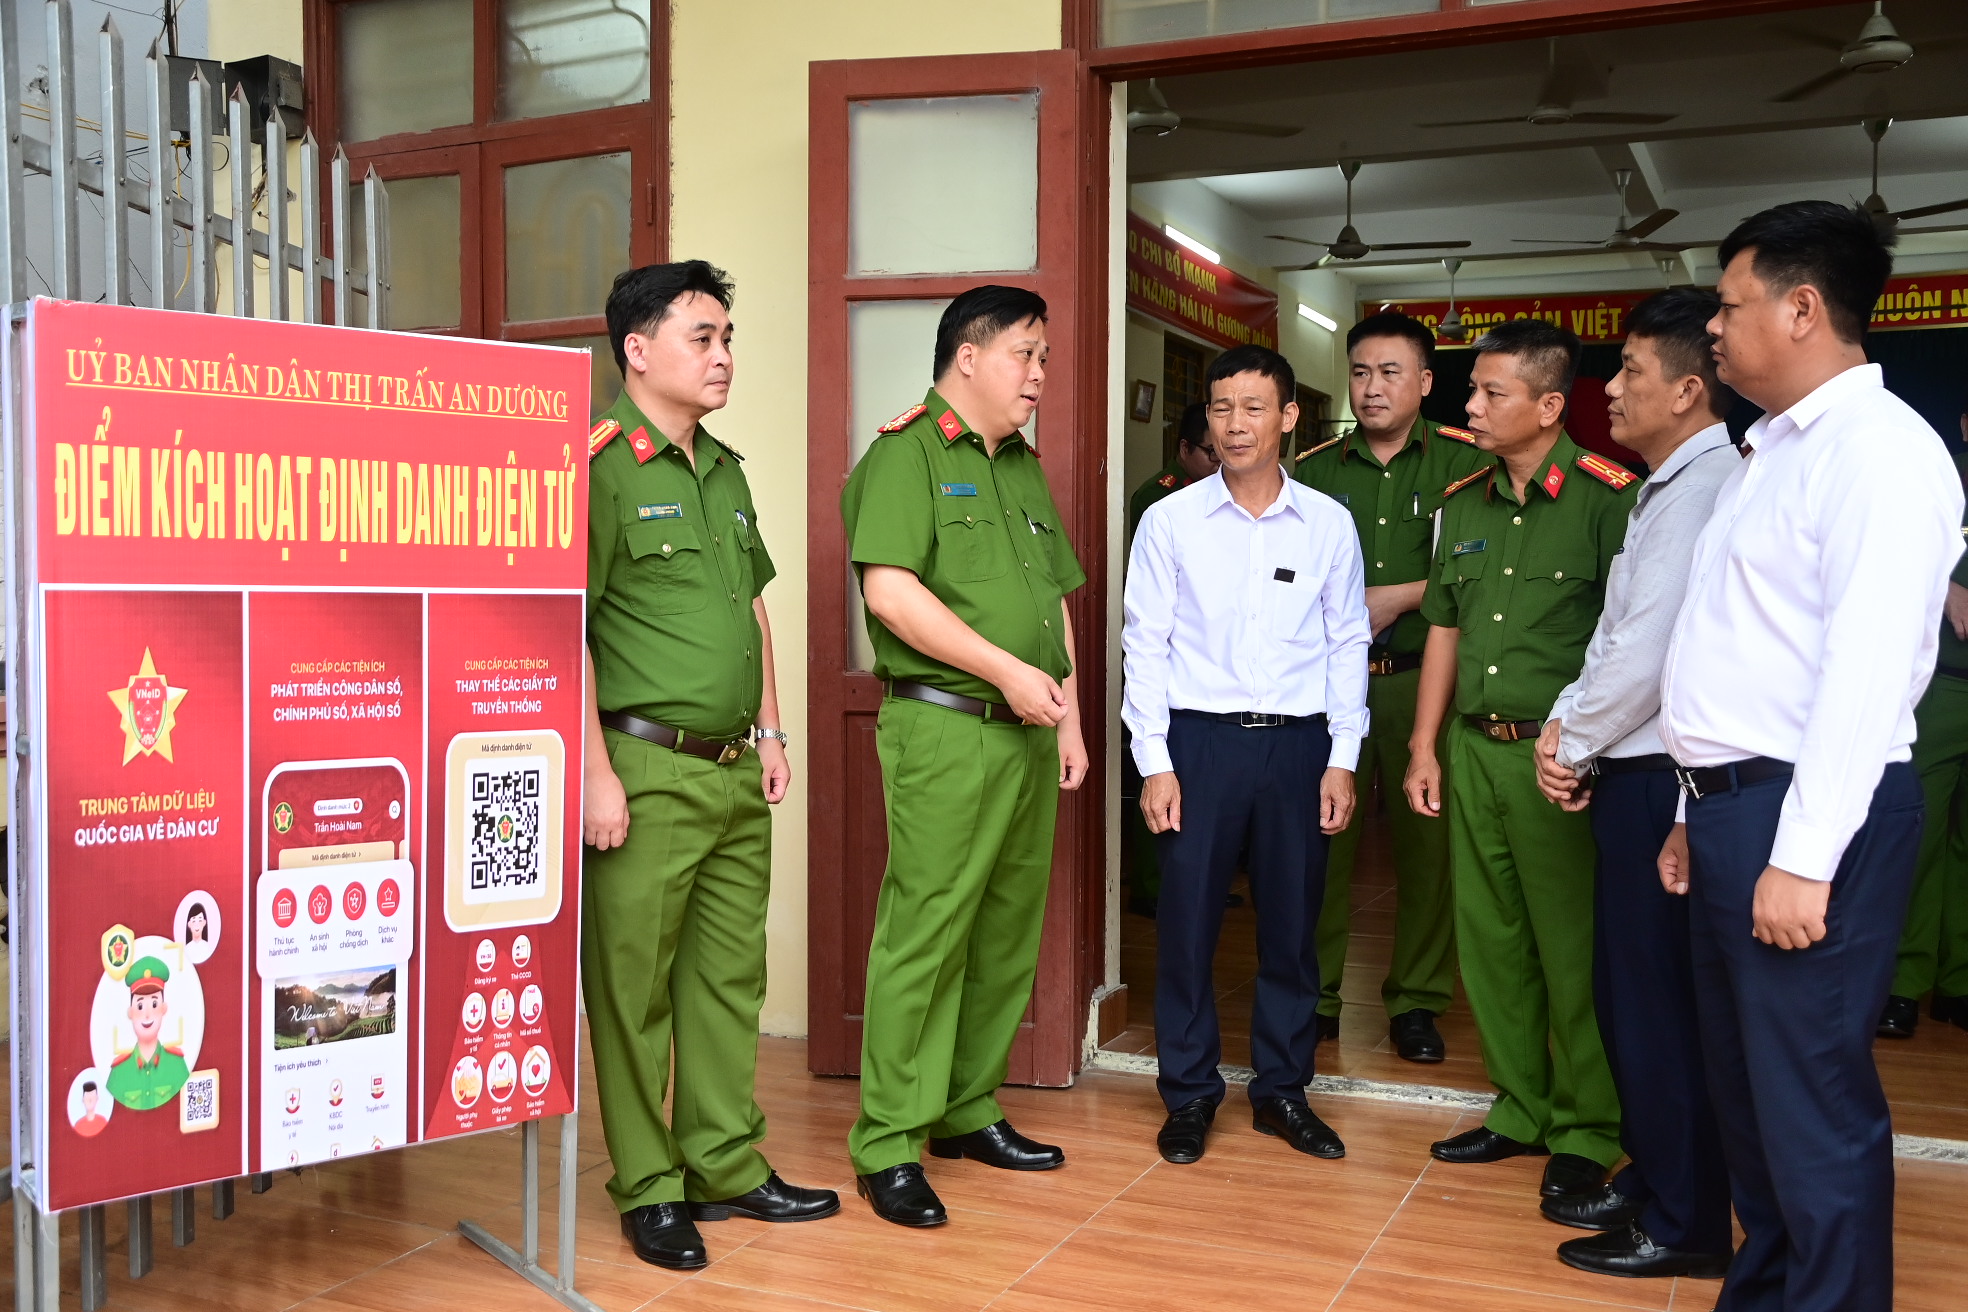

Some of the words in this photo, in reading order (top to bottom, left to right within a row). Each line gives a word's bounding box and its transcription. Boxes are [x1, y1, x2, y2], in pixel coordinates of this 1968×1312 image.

[1141, 236, 1162, 268] CHI
[1165, 249, 1181, 281] BỘ
[1183, 259, 1217, 295] MẠNH
[1142, 275, 1177, 311] HĂNG
[1179, 293, 1198, 322] HÁI
[1201, 303, 1215, 330] VÀ
[1217, 312, 1250, 345] GƯƠNG
[1571, 301, 1622, 339] VIỆT
[66, 337, 107, 383] UỶ
[114, 353, 173, 387] BAN
[180, 353, 259, 394] NHÂN
[266, 358, 321, 398] DÂN
[327, 371, 372, 411] THỊ
[378, 366, 444, 410] TRẤN
[449, 382, 482, 413] AN
[487, 384, 568, 418] DƯƠNG
[55, 406, 141, 537] ĐIỂM
[151, 429, 225, 540] KÍCH
[235, 453, 312, 561] HOẠT
[319, 457, 388, 562] ĐỊNH
[397, 462, 469, 546] DANH
[477, 451, 537, 565] ĐIỆN
[544, 443, 576, 549] TỬ
[290, 662, 315, 674] CUNG
[316, 658, 333, 673] CẤP
[334, 659, 351, 672] CÁC
[352, 659, 370, 675] TIỆN
[371, 659, 385, 672] ÍCH
[464, 660, 486, 671] CUNG
[487, 656, 502, 670] CẤP
[503, 657, 518, 670] CÁC
[519, 657, 535, 672] TIỆN
[535, 656, 549, 669] ÍCH
[271, 680, 299, 698] PHÁT
[300, 677, 331, 697] TRIỂN
[332, 679, 363, 696] CÔNG
[363, 678, 386, 695] DÂN
[386, 675, 403, 697] SỐ,
[455, 679, 480, 693] THAY
[482, 673, 500, 692] THẾ
[501, 675, 521, 692] CÁC
[522, 672, 543, 691] GIẤY
[544, 674, 558, 691] TỜ
[135, 688, 161, 699] VNeID
[273, 704, 308, 722] CHÍNH
[309, 702, 331, 720] PHỦ
[332, 700, 350, 721] SỐ,
[351, 702, 366, 719] XÃ
[367, 701, 385, 721] HỘI
[386, 698, 402, 718] SỐ
[471, 696, 508, 715] TRUYỀN
[509, 695, 542, 714] THỐNG
[501, 743, 514, 751] danh
[79, 797, 128, 816] TRUNG
[130, 791, 160, 813] TÂM
[163, 790, 184, 811] DỮ
[186, 788, 215, 813] LIỆU
[75, 819, 117, 847] QUỐC
[120, 824, 144, 842] GIA
[147, 815, 164, 840] VỀ
[167, 817, 195, 839] DÂN
[198, 816, 220, 836] CƯ
[330, 821, 346, 831] Hoài
[346, 821, 363, 830] Nam
[330, 852, 341, 860] danh
[318, 932, 330, 940] sinh
[286, 1003, 327, 1022] Welcome
[327, 1006, 338, 1017] to
